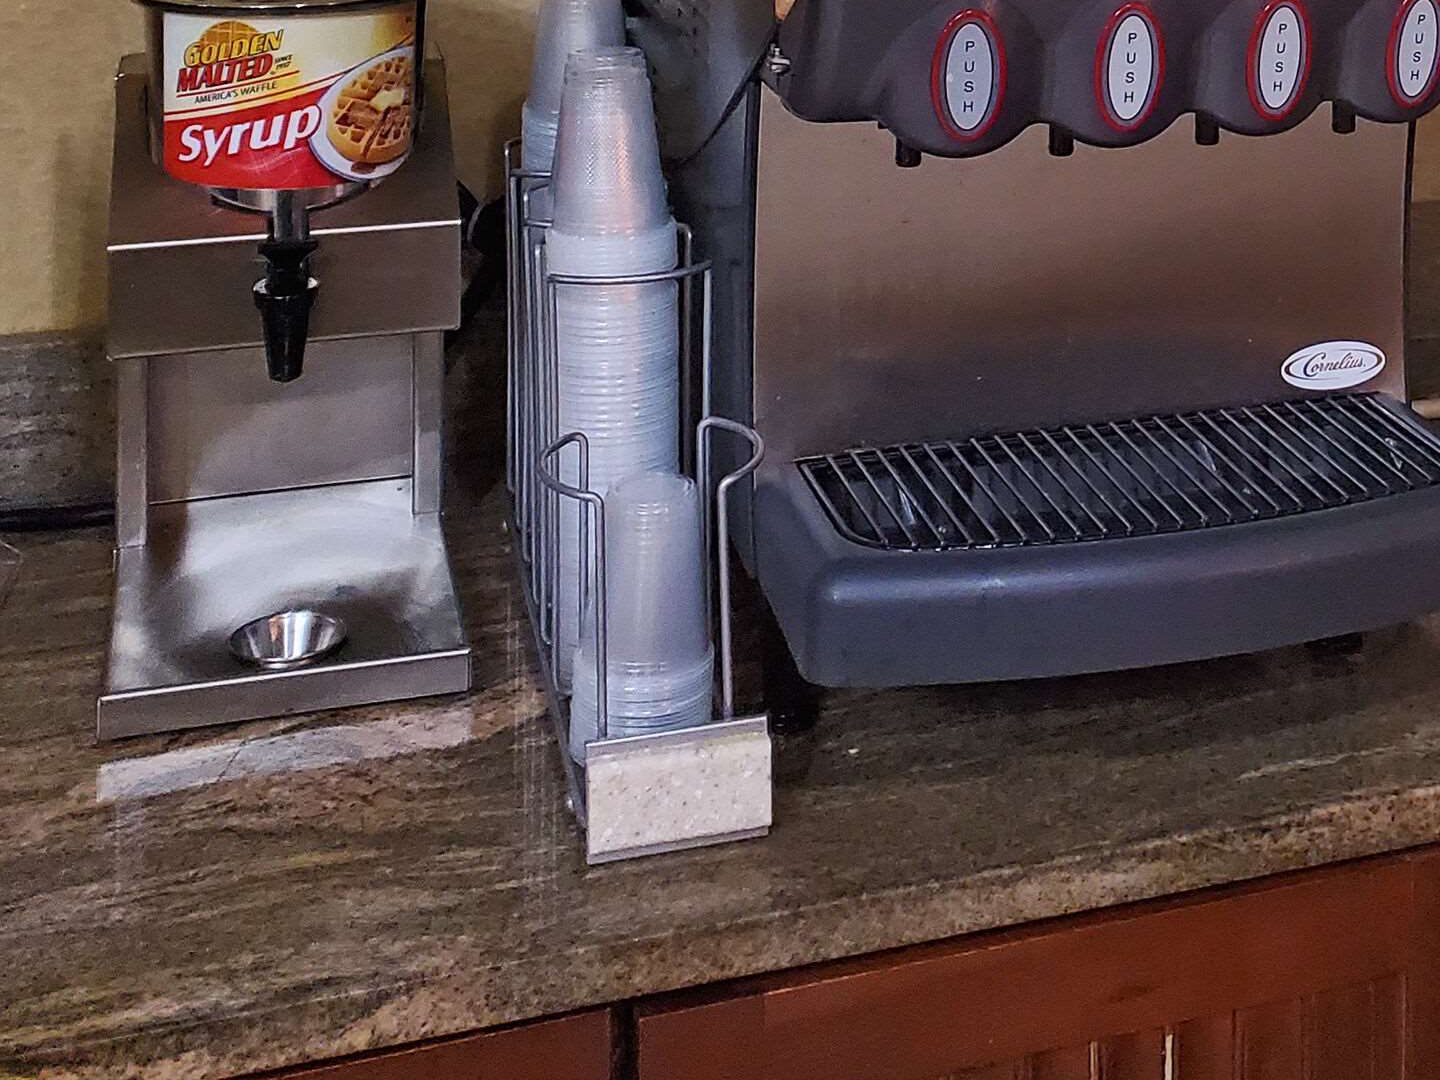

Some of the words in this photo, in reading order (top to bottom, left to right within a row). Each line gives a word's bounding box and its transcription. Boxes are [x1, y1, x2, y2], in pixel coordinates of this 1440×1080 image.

[176, 53, 274, 93] MALTED
[183, 28, 284, 68] GOLDEN
[962, 40, 977, 113] PUSH
[1122, 32, 1139, 104] PUSH
[1271, 22, 1289, 93] PUSH
[1409, 13, 1428, 82] PUSH
[194, 87, 239, 105] AMERICA'S
[240, 80, 278, 97] WAFFLE
[177, 103, 322, 168] Syrup
[1303, 351, 1363, 377] Cornelius
